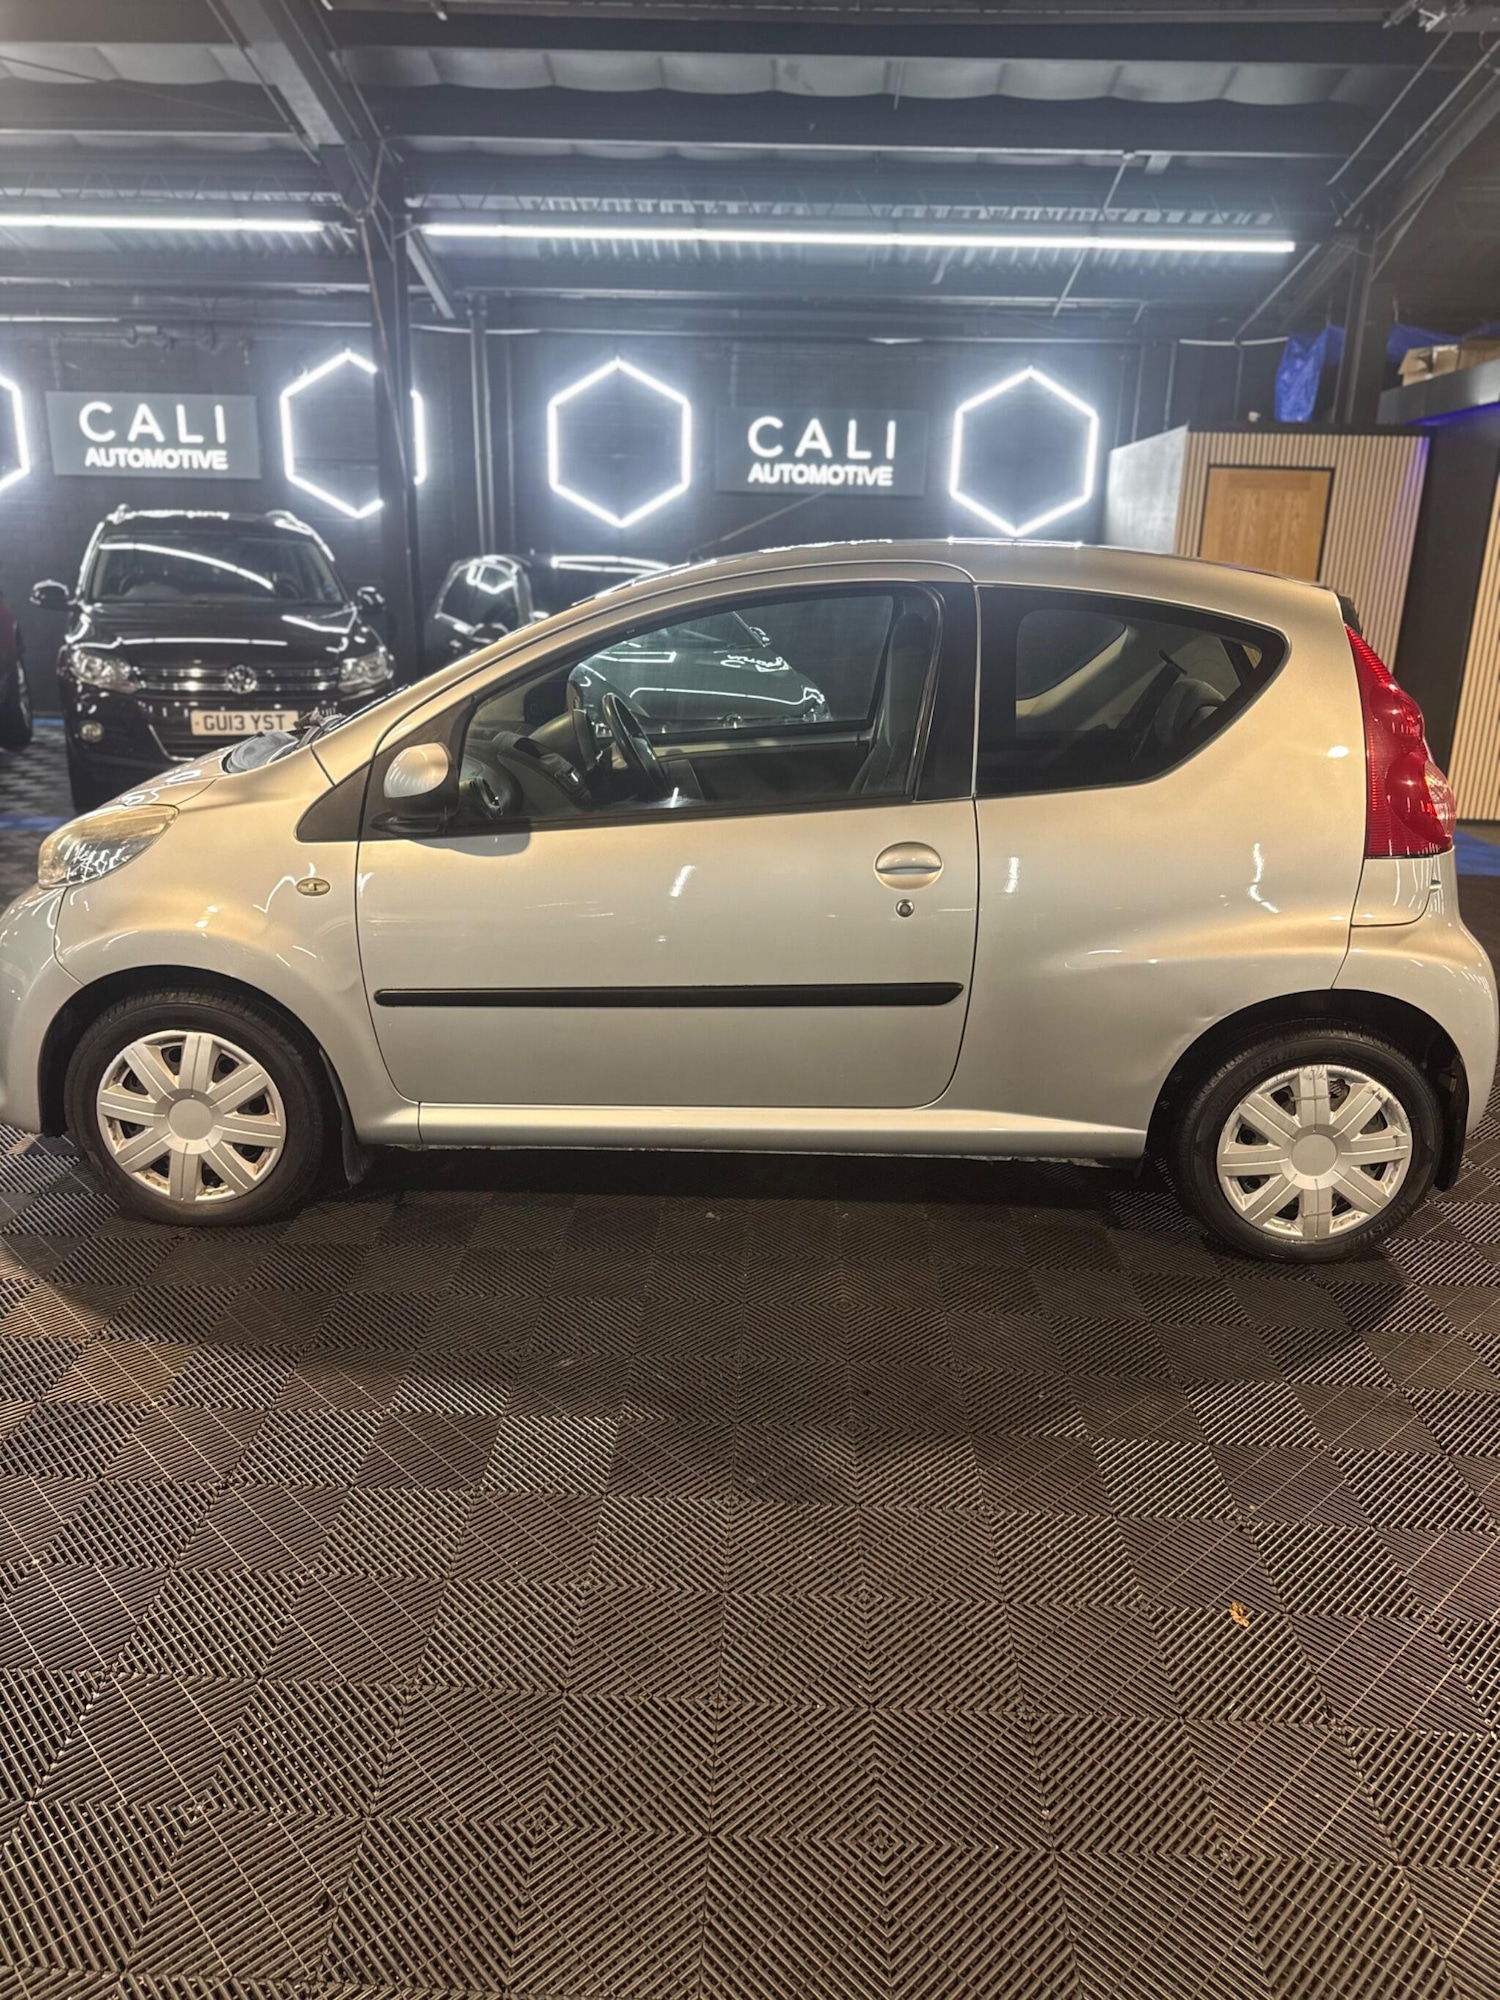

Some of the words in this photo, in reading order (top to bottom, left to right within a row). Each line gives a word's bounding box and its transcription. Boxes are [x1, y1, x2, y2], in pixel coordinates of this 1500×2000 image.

[78, 401, 227, 444] CALI
[747, 415, 897, 460] CALI
[84, 447, 229, 470] AUTOMOTIVE
[747, 462, 894, 486] AUTOMOTIVE
[203, 715, 245, 731] GU13
[250, 714, 286, 730] YST
